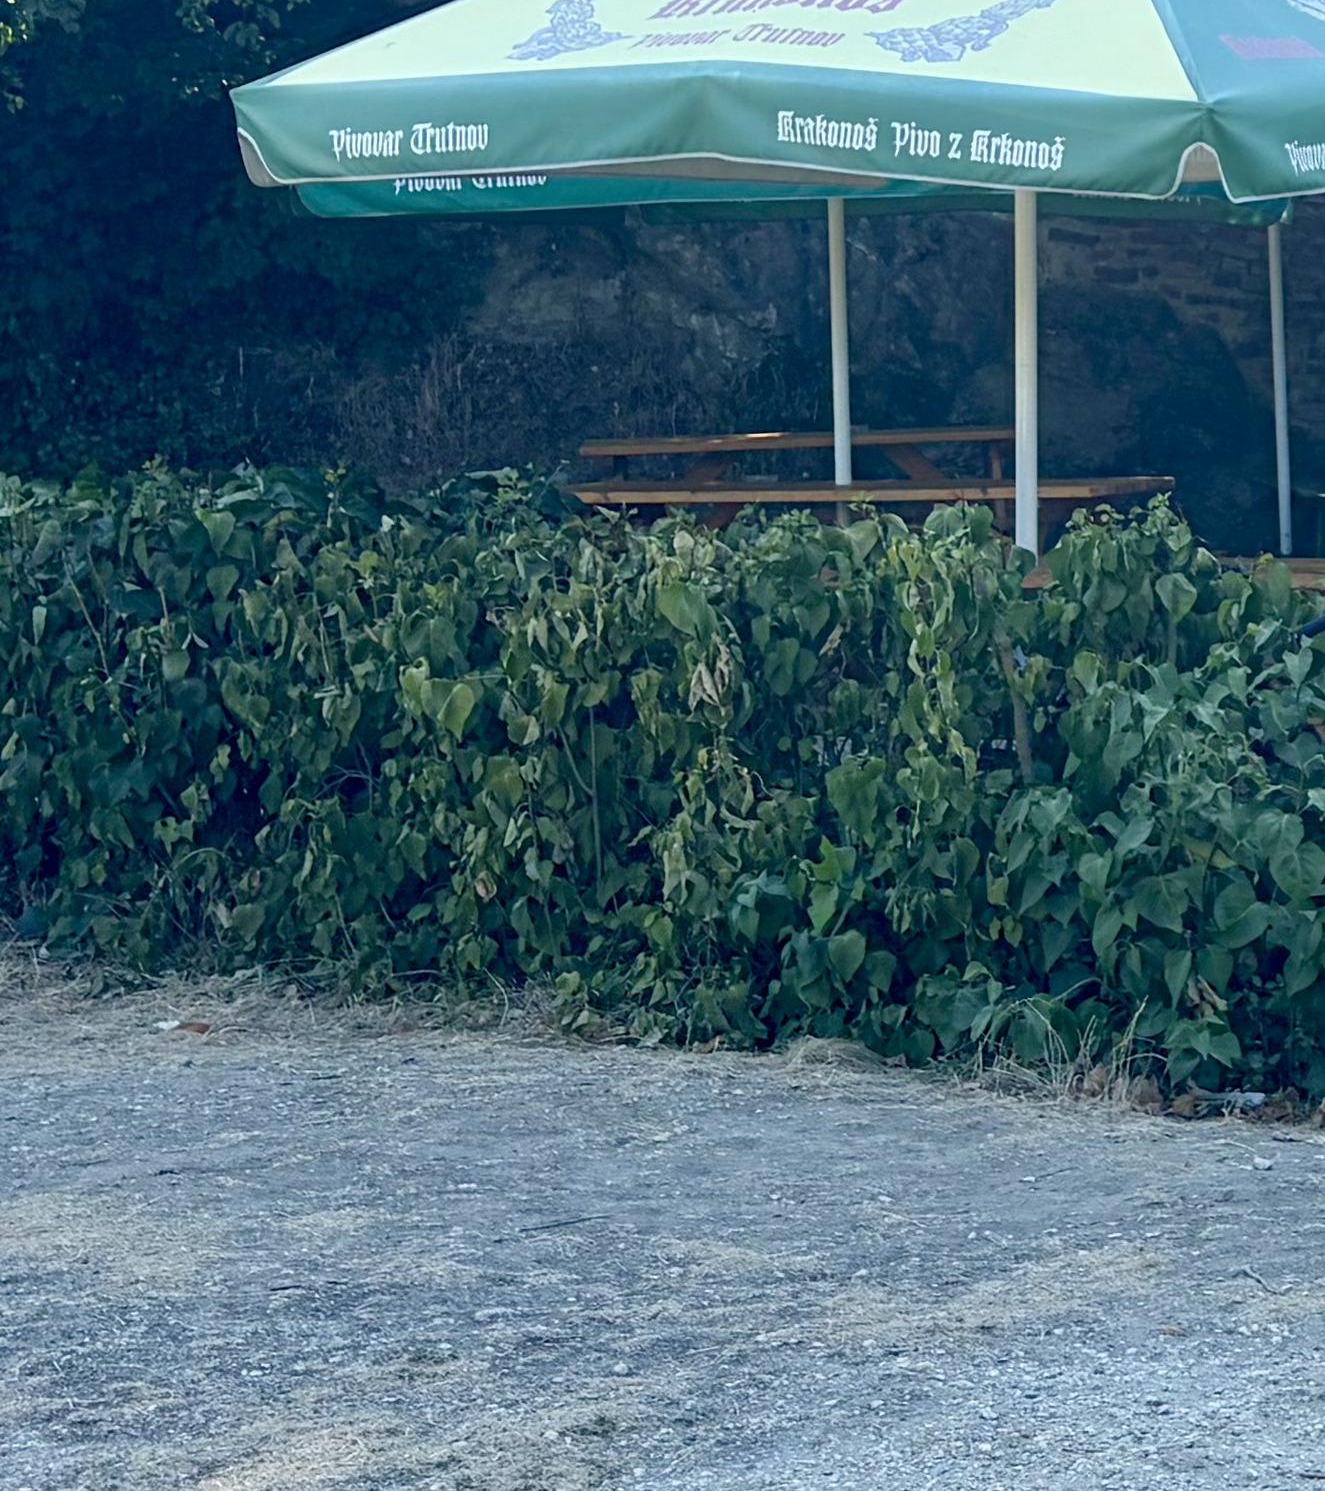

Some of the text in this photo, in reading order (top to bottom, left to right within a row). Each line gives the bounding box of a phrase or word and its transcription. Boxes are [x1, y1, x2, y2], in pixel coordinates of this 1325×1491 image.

[329, 121, 489, 162] Pivovar Trutnov
[777, 110, 1066, 171] Krakonoš Pivo z Krkonoš
